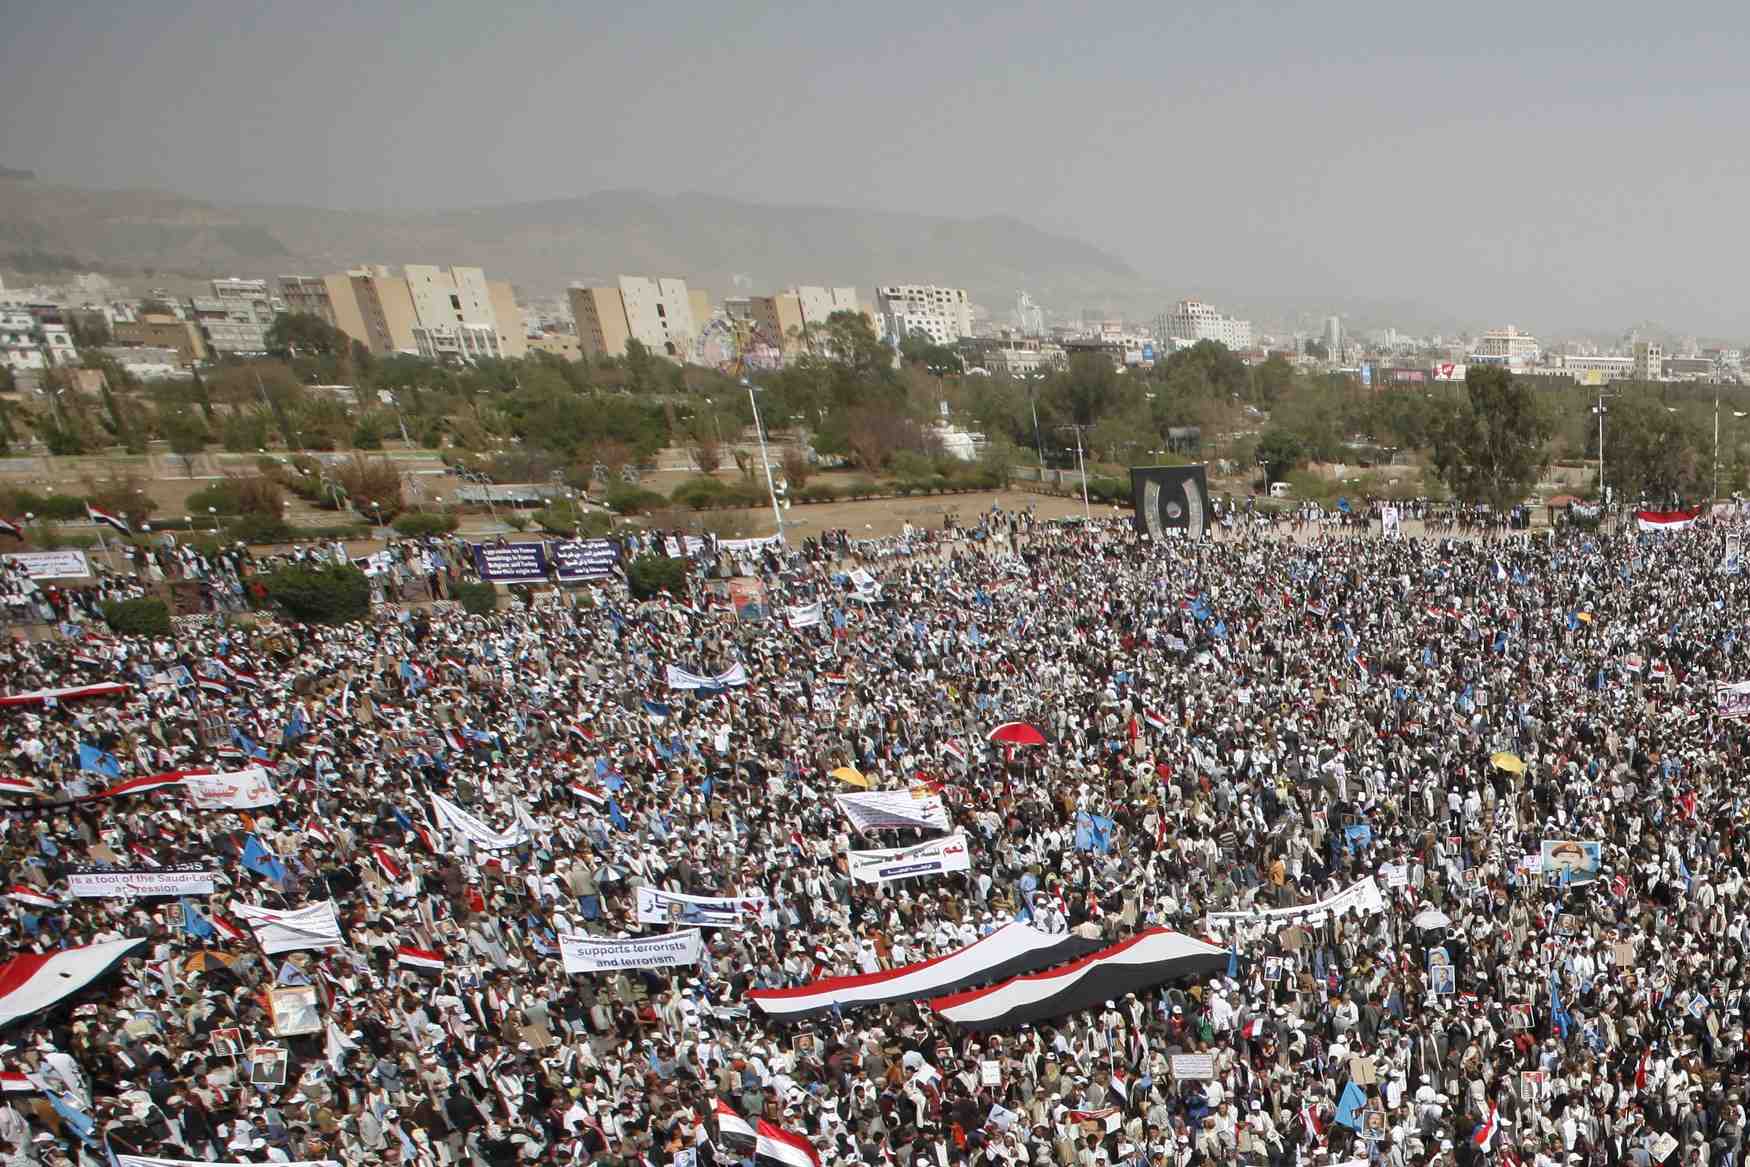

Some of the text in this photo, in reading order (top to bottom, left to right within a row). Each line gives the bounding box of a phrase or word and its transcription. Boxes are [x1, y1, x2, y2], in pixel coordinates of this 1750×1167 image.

[95, 874, 119, 884] tool
[577, 940, 687, 958] supports terrorists
[596, 954, 676, 968] and terrorism
